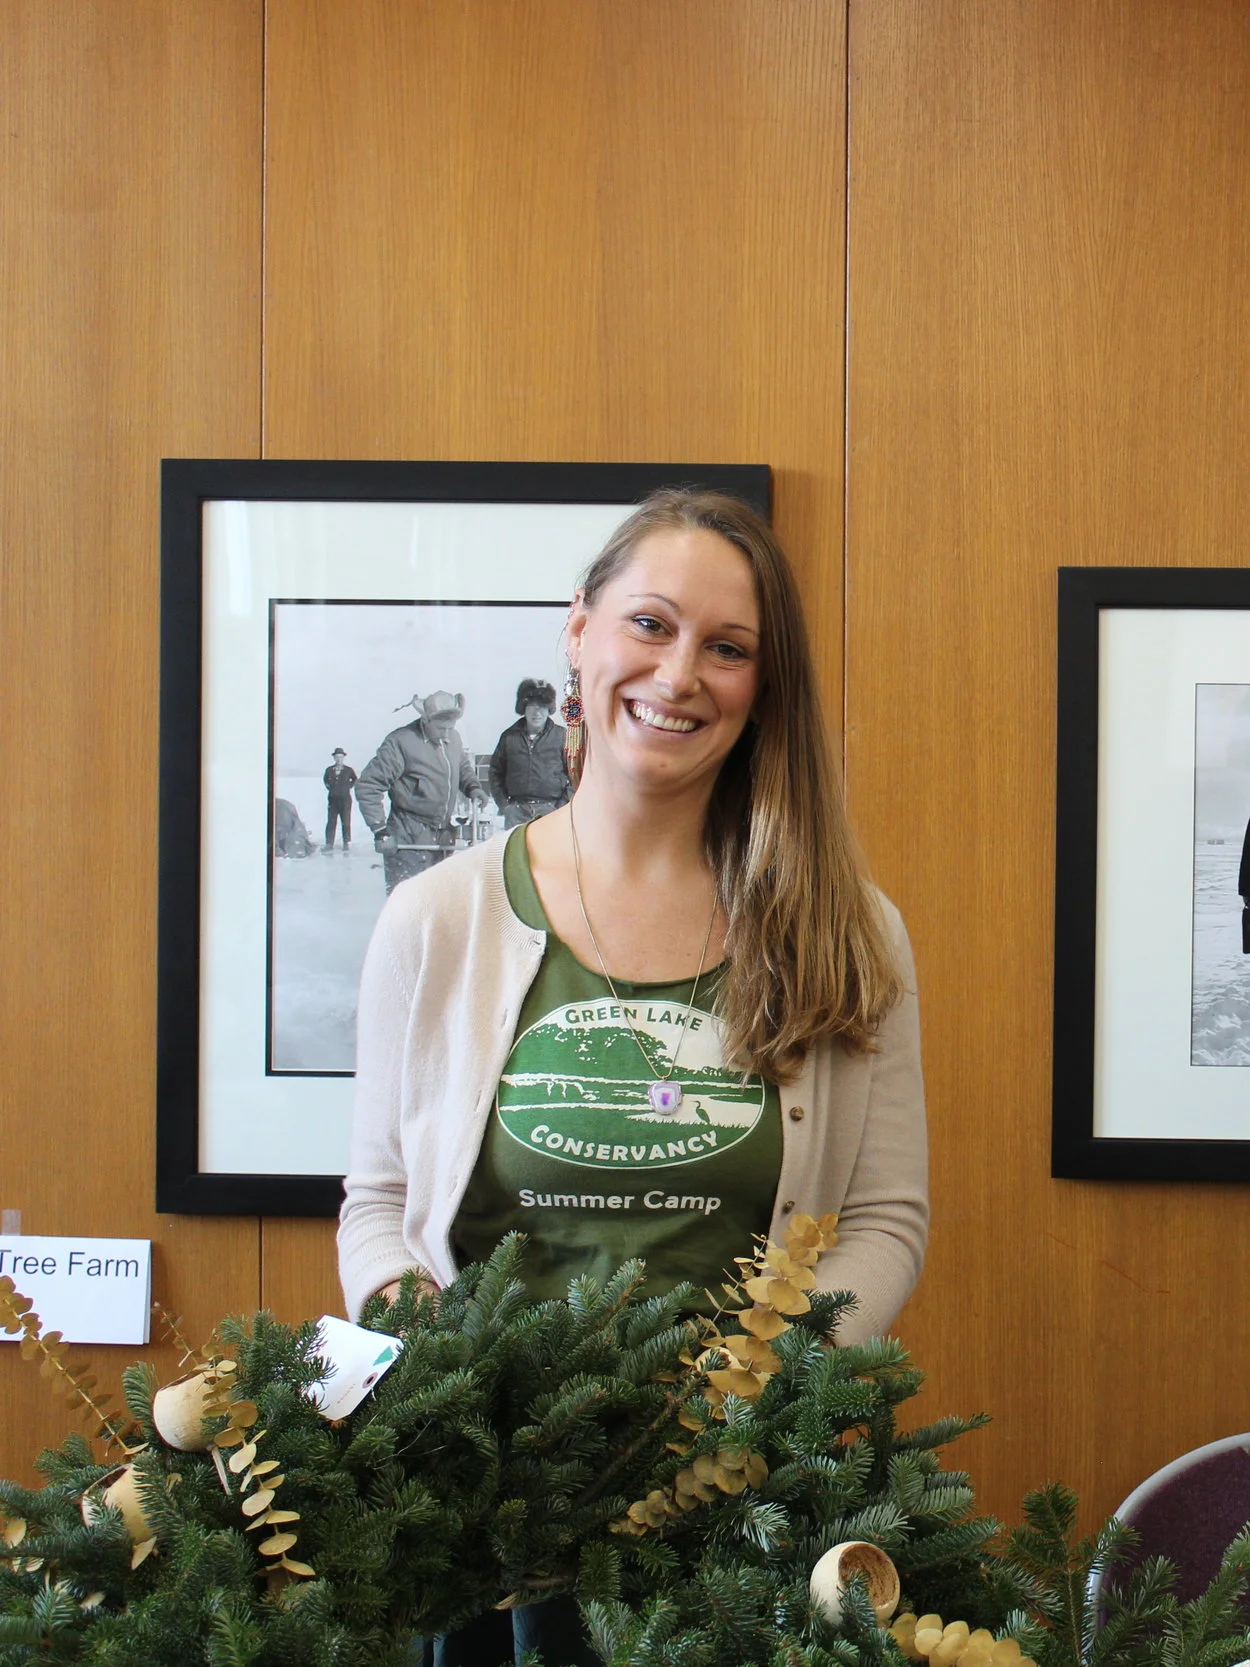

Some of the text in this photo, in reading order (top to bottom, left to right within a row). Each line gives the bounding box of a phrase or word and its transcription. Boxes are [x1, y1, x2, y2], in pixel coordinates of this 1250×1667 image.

[565, 1005, 703, 1032] GREEN LAKE
[530, 1124, 719, 1161] CONSERVANCY
[519, 1189, 721, 1215] Summer Camp
[68, 1252, 139, 1277] Farm
